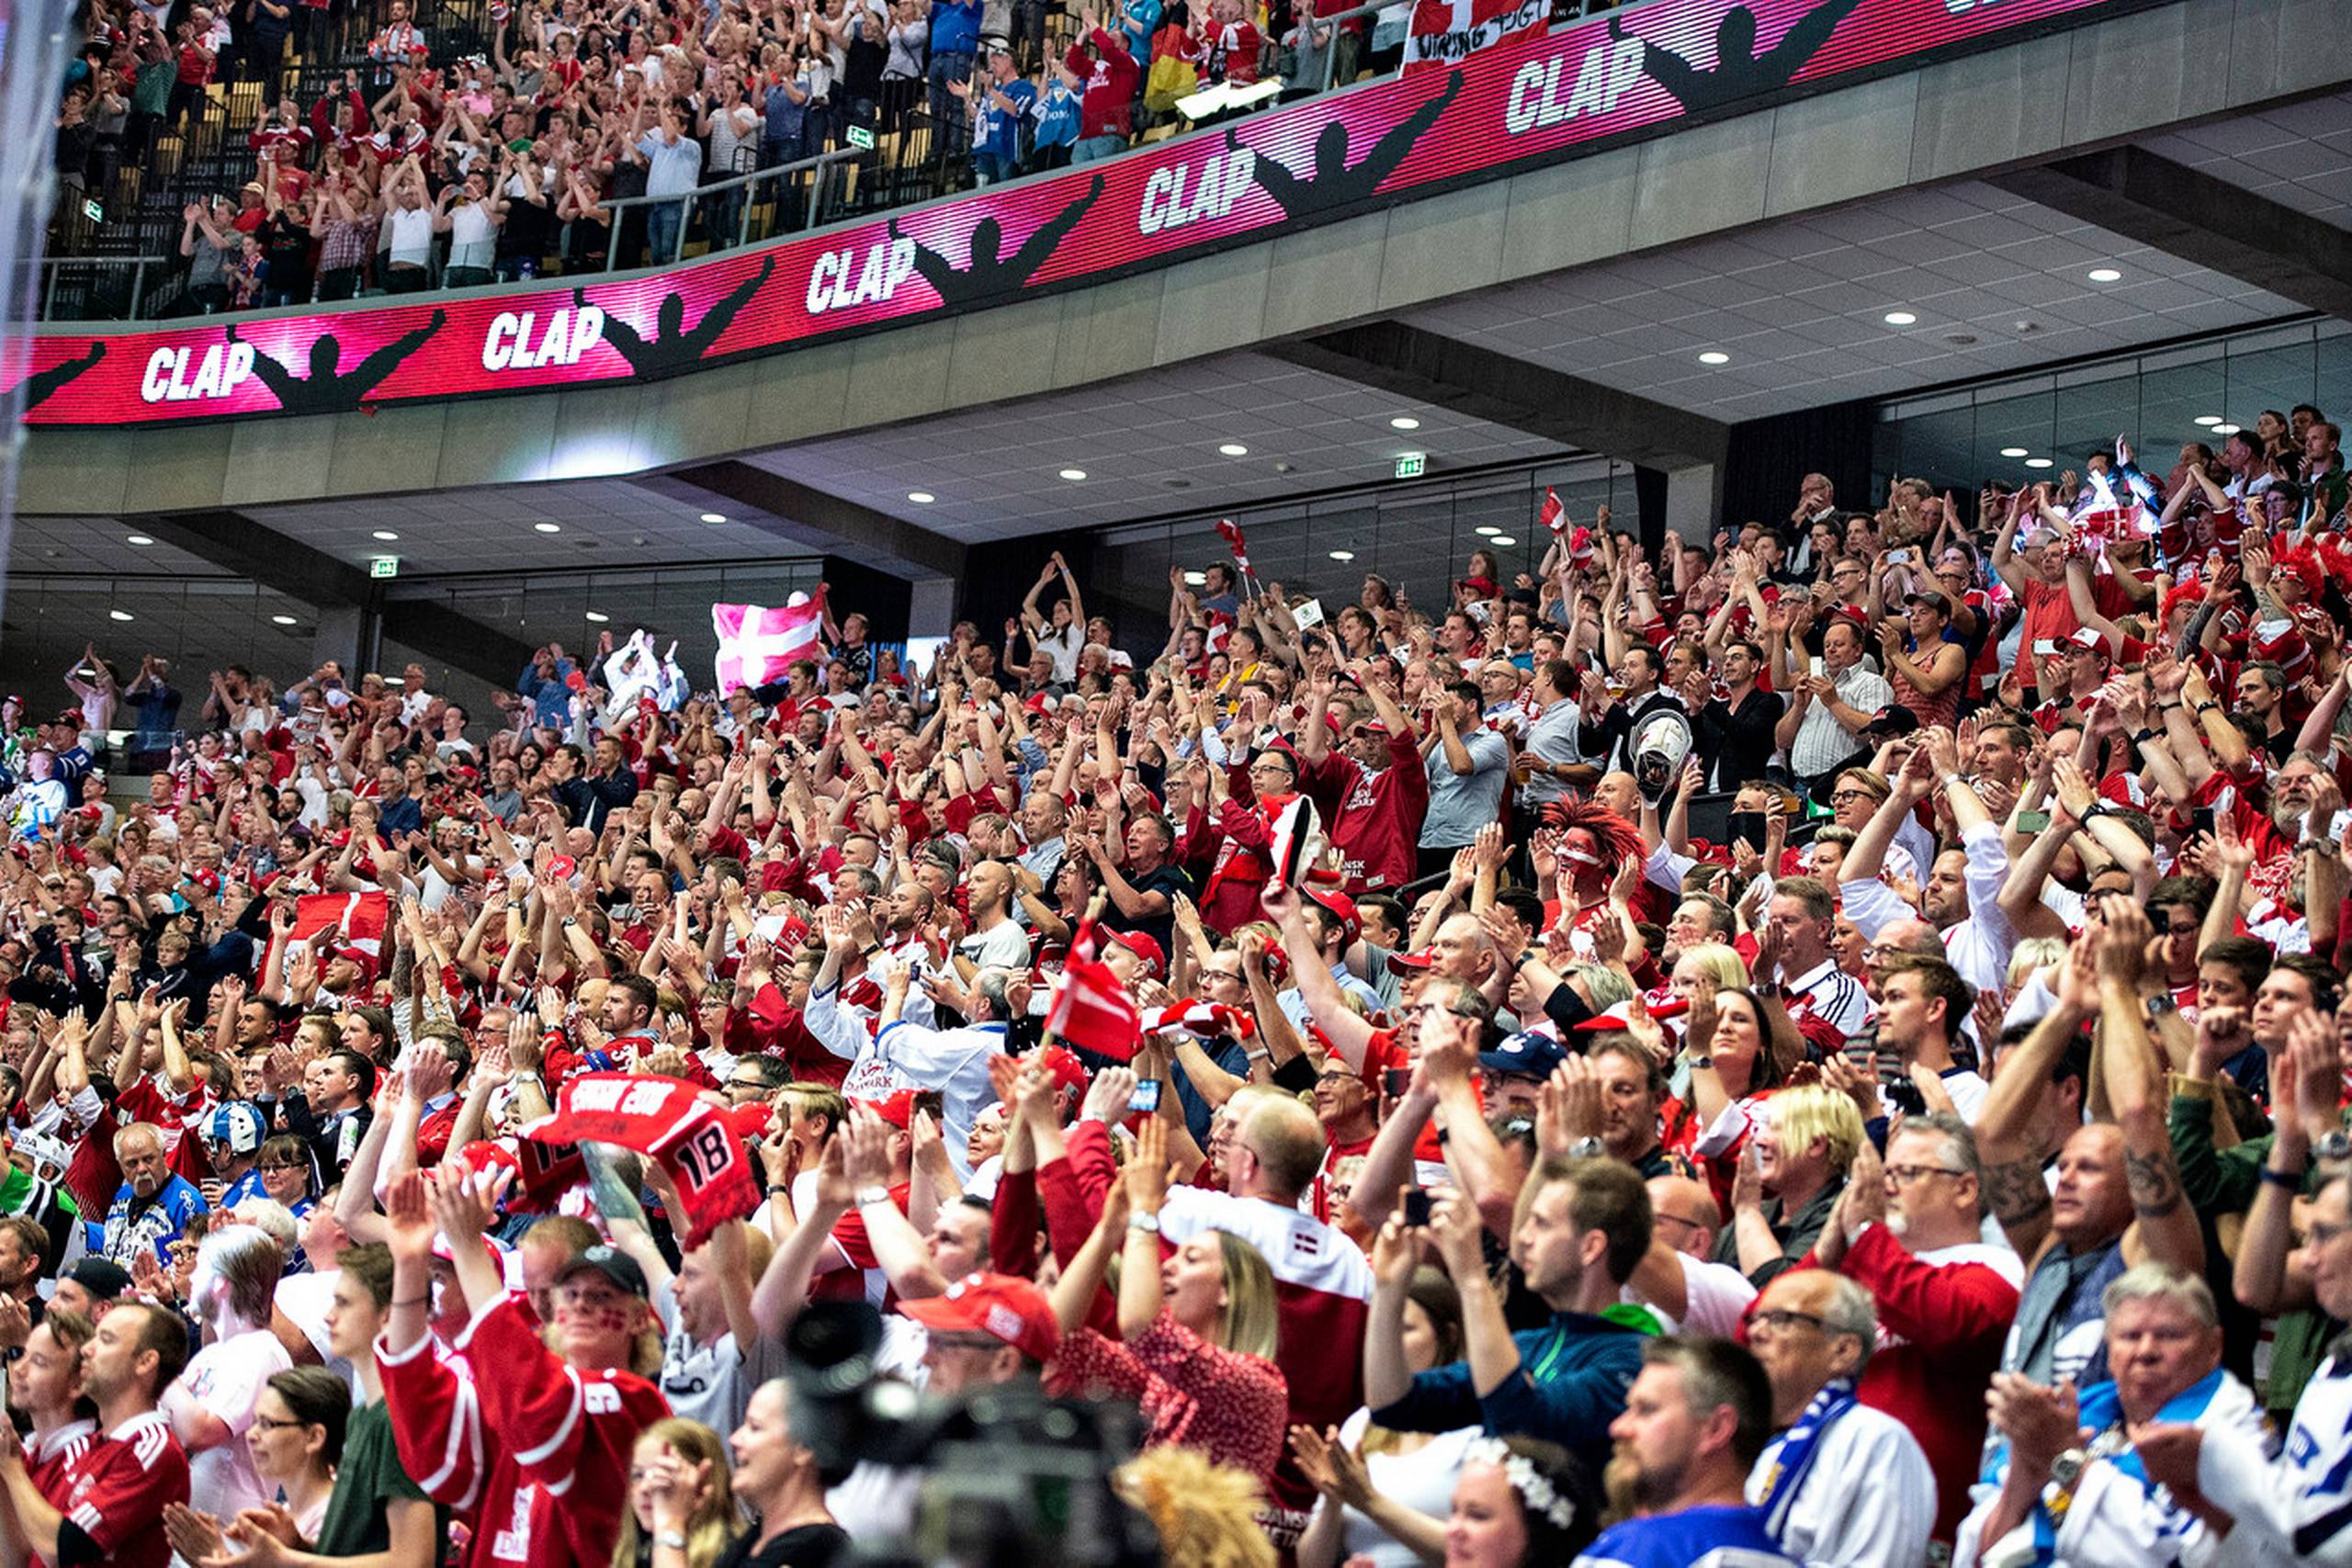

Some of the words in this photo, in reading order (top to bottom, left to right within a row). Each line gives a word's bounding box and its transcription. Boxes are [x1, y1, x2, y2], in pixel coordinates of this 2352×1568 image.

[1506, 36, 1645, 134] CLAP
[1138, 147, 1256, 235] CLAP
[806, 237, 917, 314] CLAP
[141, 341, 255, 403] CLAP
[482, 305, 605, 372] CLAP
[673, 1120, 734, 1194] 18
